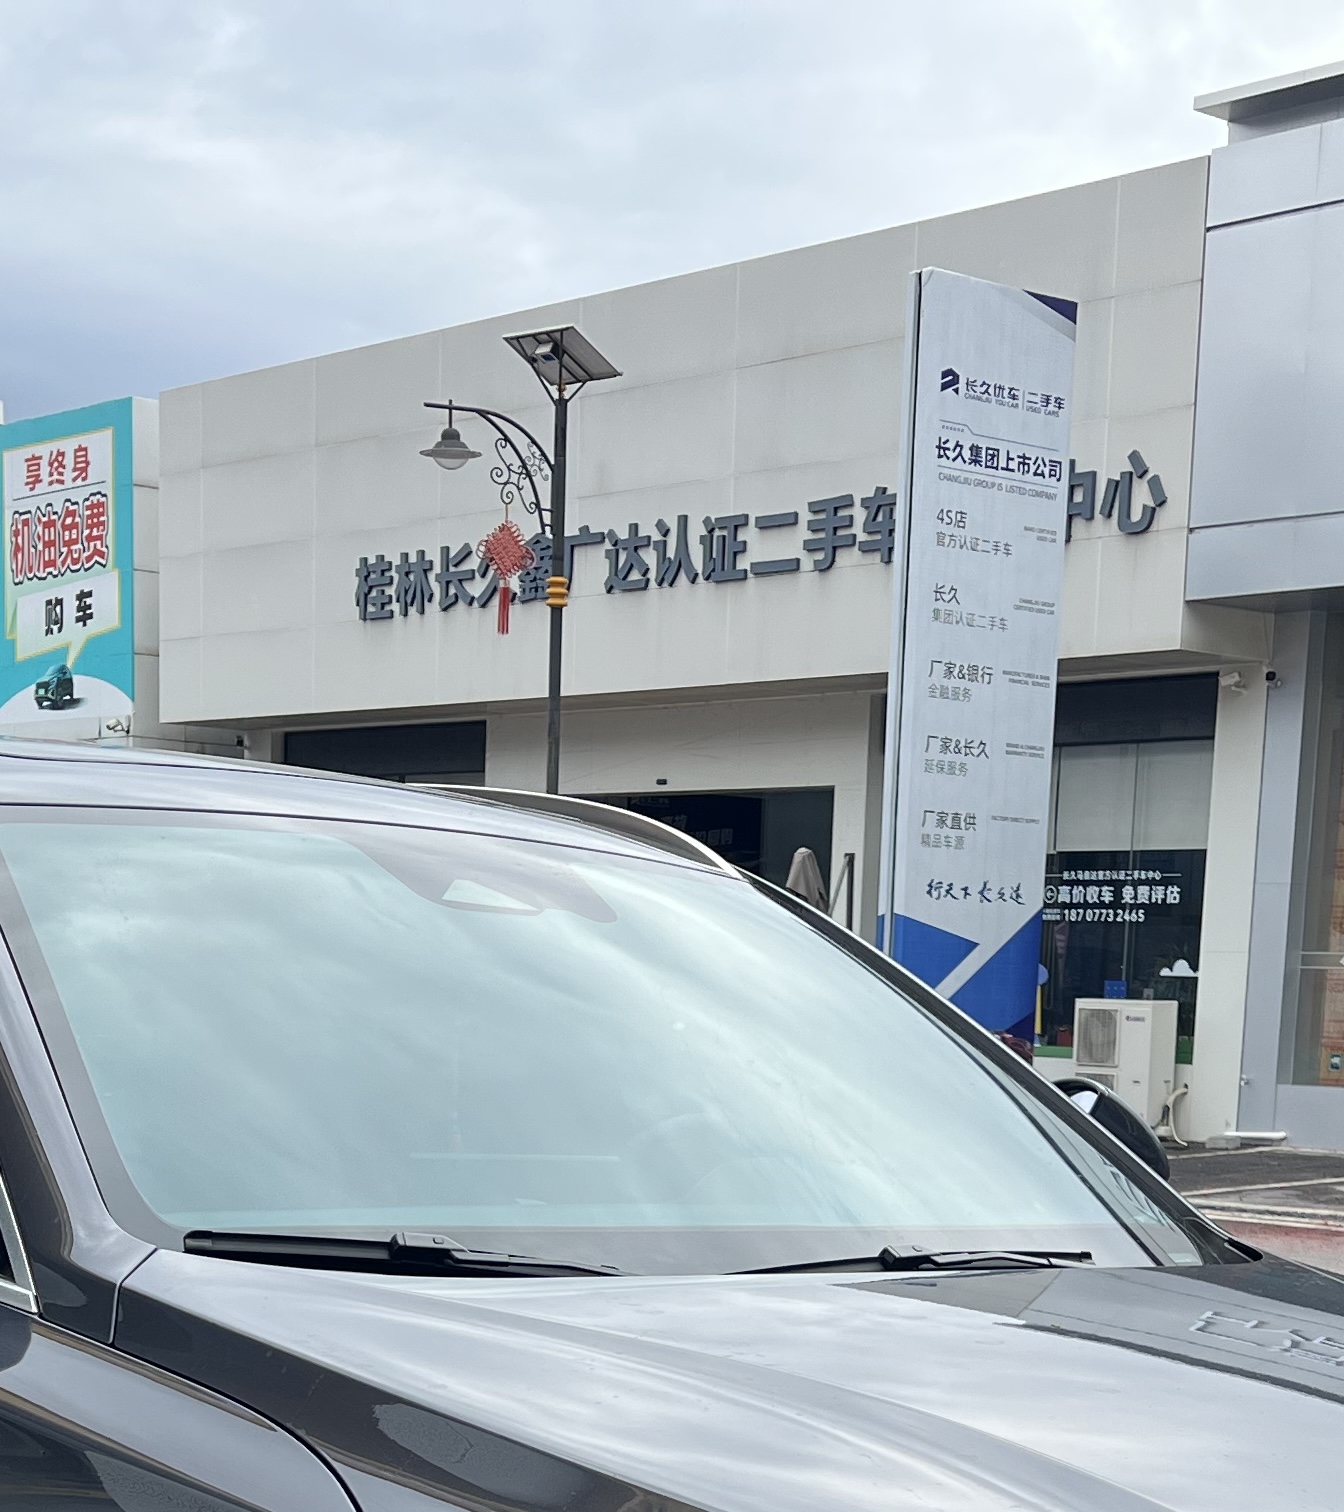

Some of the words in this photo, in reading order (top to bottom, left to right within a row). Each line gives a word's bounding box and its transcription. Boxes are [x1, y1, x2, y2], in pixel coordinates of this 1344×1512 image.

[965, 377, 1020, 401] 长久优车
[1026, 391, 1065, 411] 二手车
[24, 444, 91, 492] 享终身
[936, 436, 1062, 482] 长久集团上市公司
[972, 478, 996, 490] GROUP
[1005, 484, 1027, 496] LISTED
[1027, 487, 1058, 501] COMPANY
[936, 508, 967, 530] 4S店
[10, 491, 109, 586] 机油免费
[936, 531, 1013, 557] 官方认证二手车
[933, 582, 961, 605] 长久
[44, 588, 94, 637] 购车
[931, 607, 1009, 632] 集团认证二手车
[928, 659, 994, 685] 厂家&银行
[927, 682, 973, 702] 金融服务
[924, 735, 990, 760] 厂家&长久
[921, 809, 977, 832] 厂家直供
[1057, 884, 1115, 904] 高价收车
[1120, 884, 1181, 904] 免费评估
